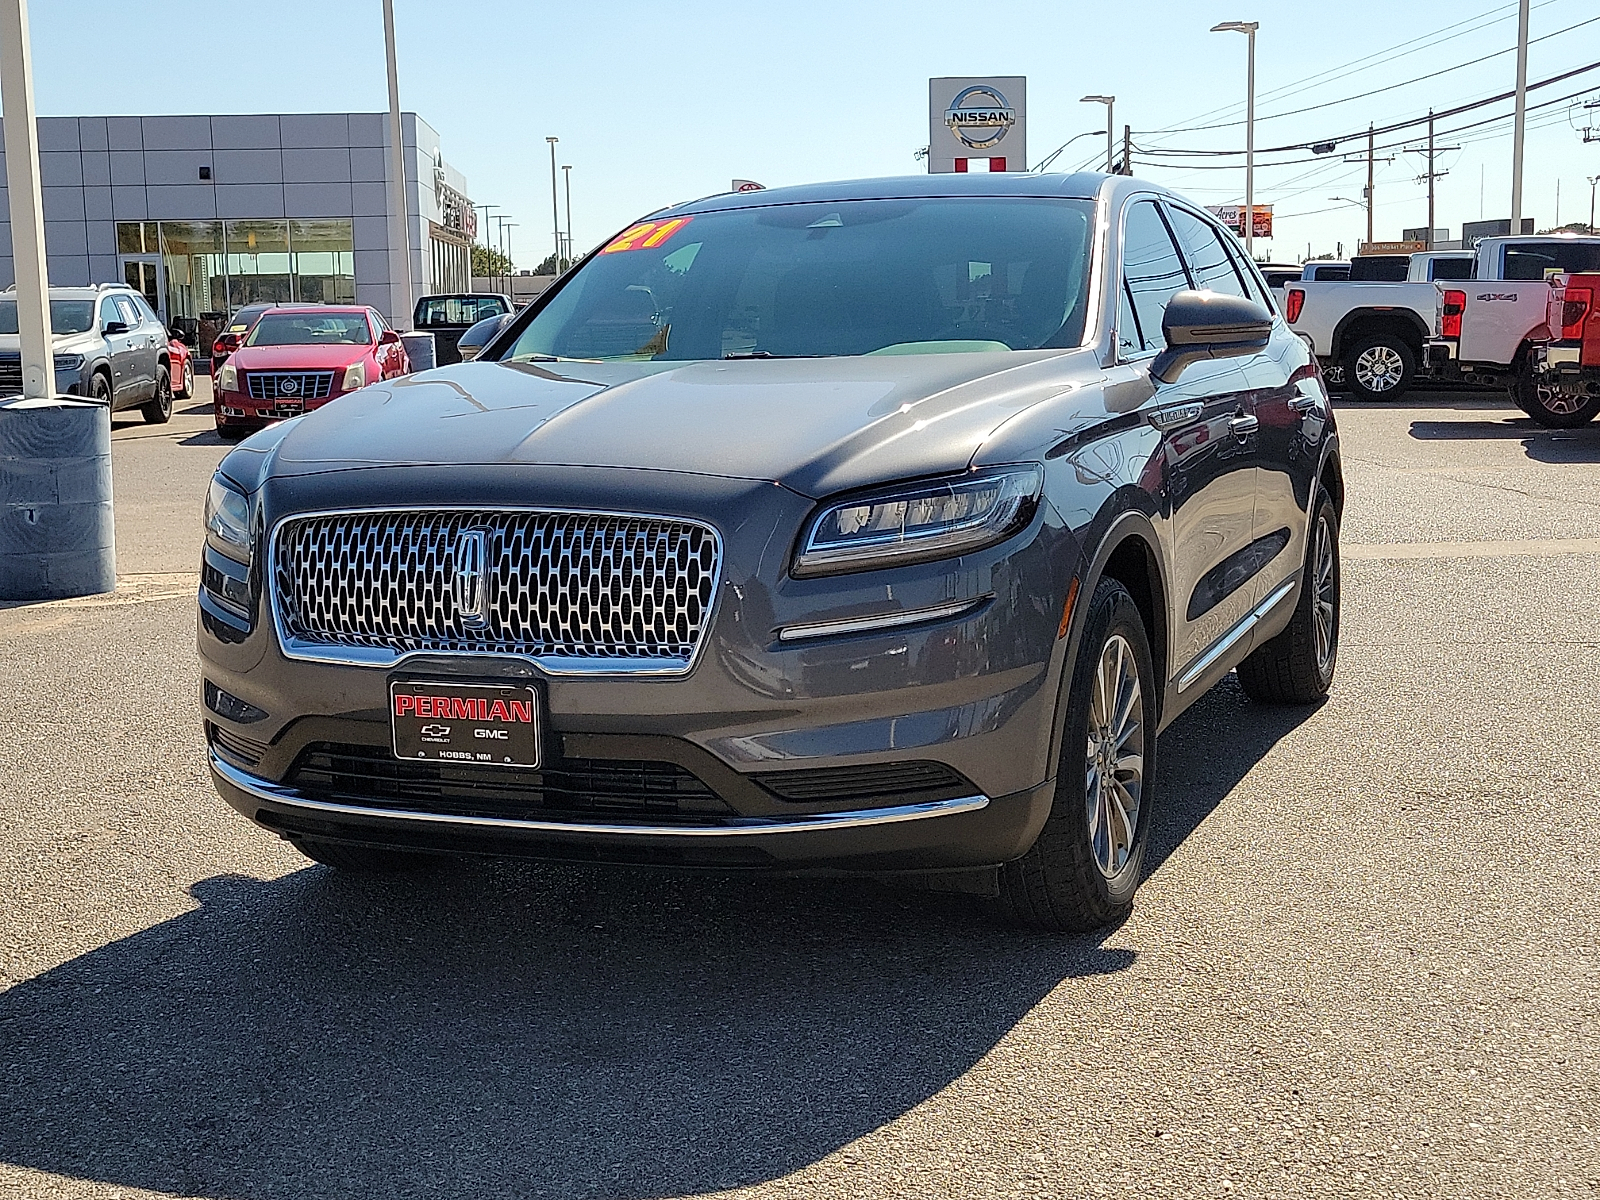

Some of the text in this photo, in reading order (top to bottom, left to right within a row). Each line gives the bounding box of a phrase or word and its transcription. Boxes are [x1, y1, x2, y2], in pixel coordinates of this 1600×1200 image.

[952, 111, 1009, 122] NISSAN
[1216, 207, 1237, 220] Acres
[605, 219, 685, 253] 21
[395, 694, 532, 722] PERMIAN
[474, 728, 508, 739] GMC
[439, 750, 492, 761] HOBBS, NM
